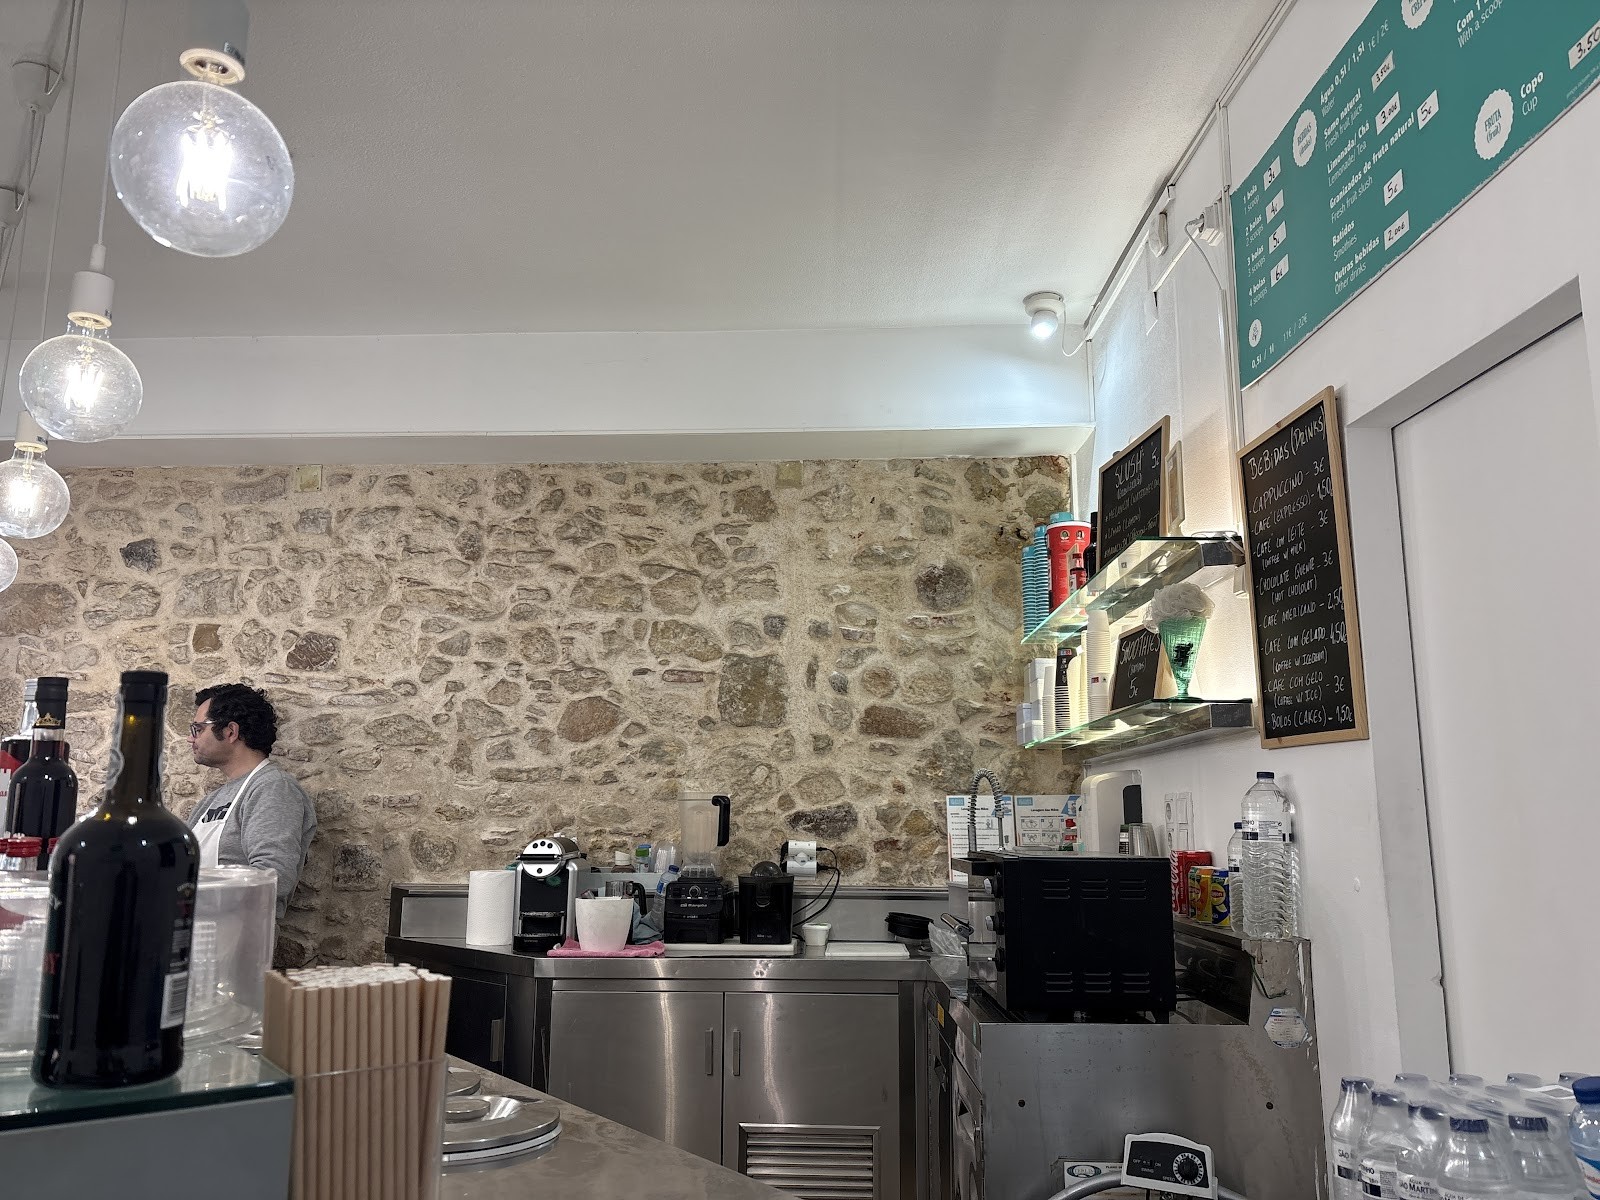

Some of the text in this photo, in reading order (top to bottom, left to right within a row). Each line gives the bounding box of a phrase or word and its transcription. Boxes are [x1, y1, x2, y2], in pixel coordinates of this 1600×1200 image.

[1457, 10, 1474, 32] Com
[1368, 36, 1376, 52] 1€
[1381, 20, 1389, 37] 2€
[1458, 27, 1474, 48] With
[1475, 21, 1480, 30] a
[1520, 72, 1544, 99] Copo
[1324, 88, 1361, 139] Sumo natural
[1522, 96, 1538, 116] Cup
[1358, 120, 1370, 138] Chá
[1485, 108, 1502, 132] FRUTA
[1325, 131, 1340, 152] Fresh
[1487, 122, 1501, 143] (fruit)
[1357, 141, 1367, 155] Tea
[1330, 111, 1414, 209] Granizados de fruta natural
[1247, 184, 1257, 200] bola
[1332, 176, 1373, 223] Fresh fruit slush
[1245, 214, 1262, 236] 2 bolas
[1250, 224, 1264, 243] scoops
[1333, 220, 1355, 247] Batidos
[1247, 245, 1264, 266] 3 bolas
[1334, 234, 1358, 262] Smoothies
[1252, 255, 1266, 273] scoops
[1335, 237, 1380, 282] Outras bebidas
[1249, 277, 1266, 297] 4 bolas
[1335, 262, 1366, 294] Other drinks
[1253, 287, 1268, 305] scoops
[1151, 447, 1159, 469] 5€
[1253, 471, 1304, 514] CAPPUCCINO
[1313, 457, 1325, 476] 3€
[1288, 522, 1304, 542] LEITE
[1318, 509, 1328, 528] 3€
[1260, 569, 1290, 596] CHOCOLATE
[1322, 550, 1333, 567] 3€
[1264, 610, 1279, 629] CAFÉ
[1282, 602, 1316, 624] AMERICANO
[1129, 677, 1139, 699] 5€
[1289, 676, 1303, 689] COM
[1306, 671, 1323, 686] GELO
[1334, 675, 1345, 693] 3€
[1305, 685, 1322, 702] ICE)
[1271, 713, 1292, 730] BOLOS
[1294, 704, 1327, 728] (CAKES)
